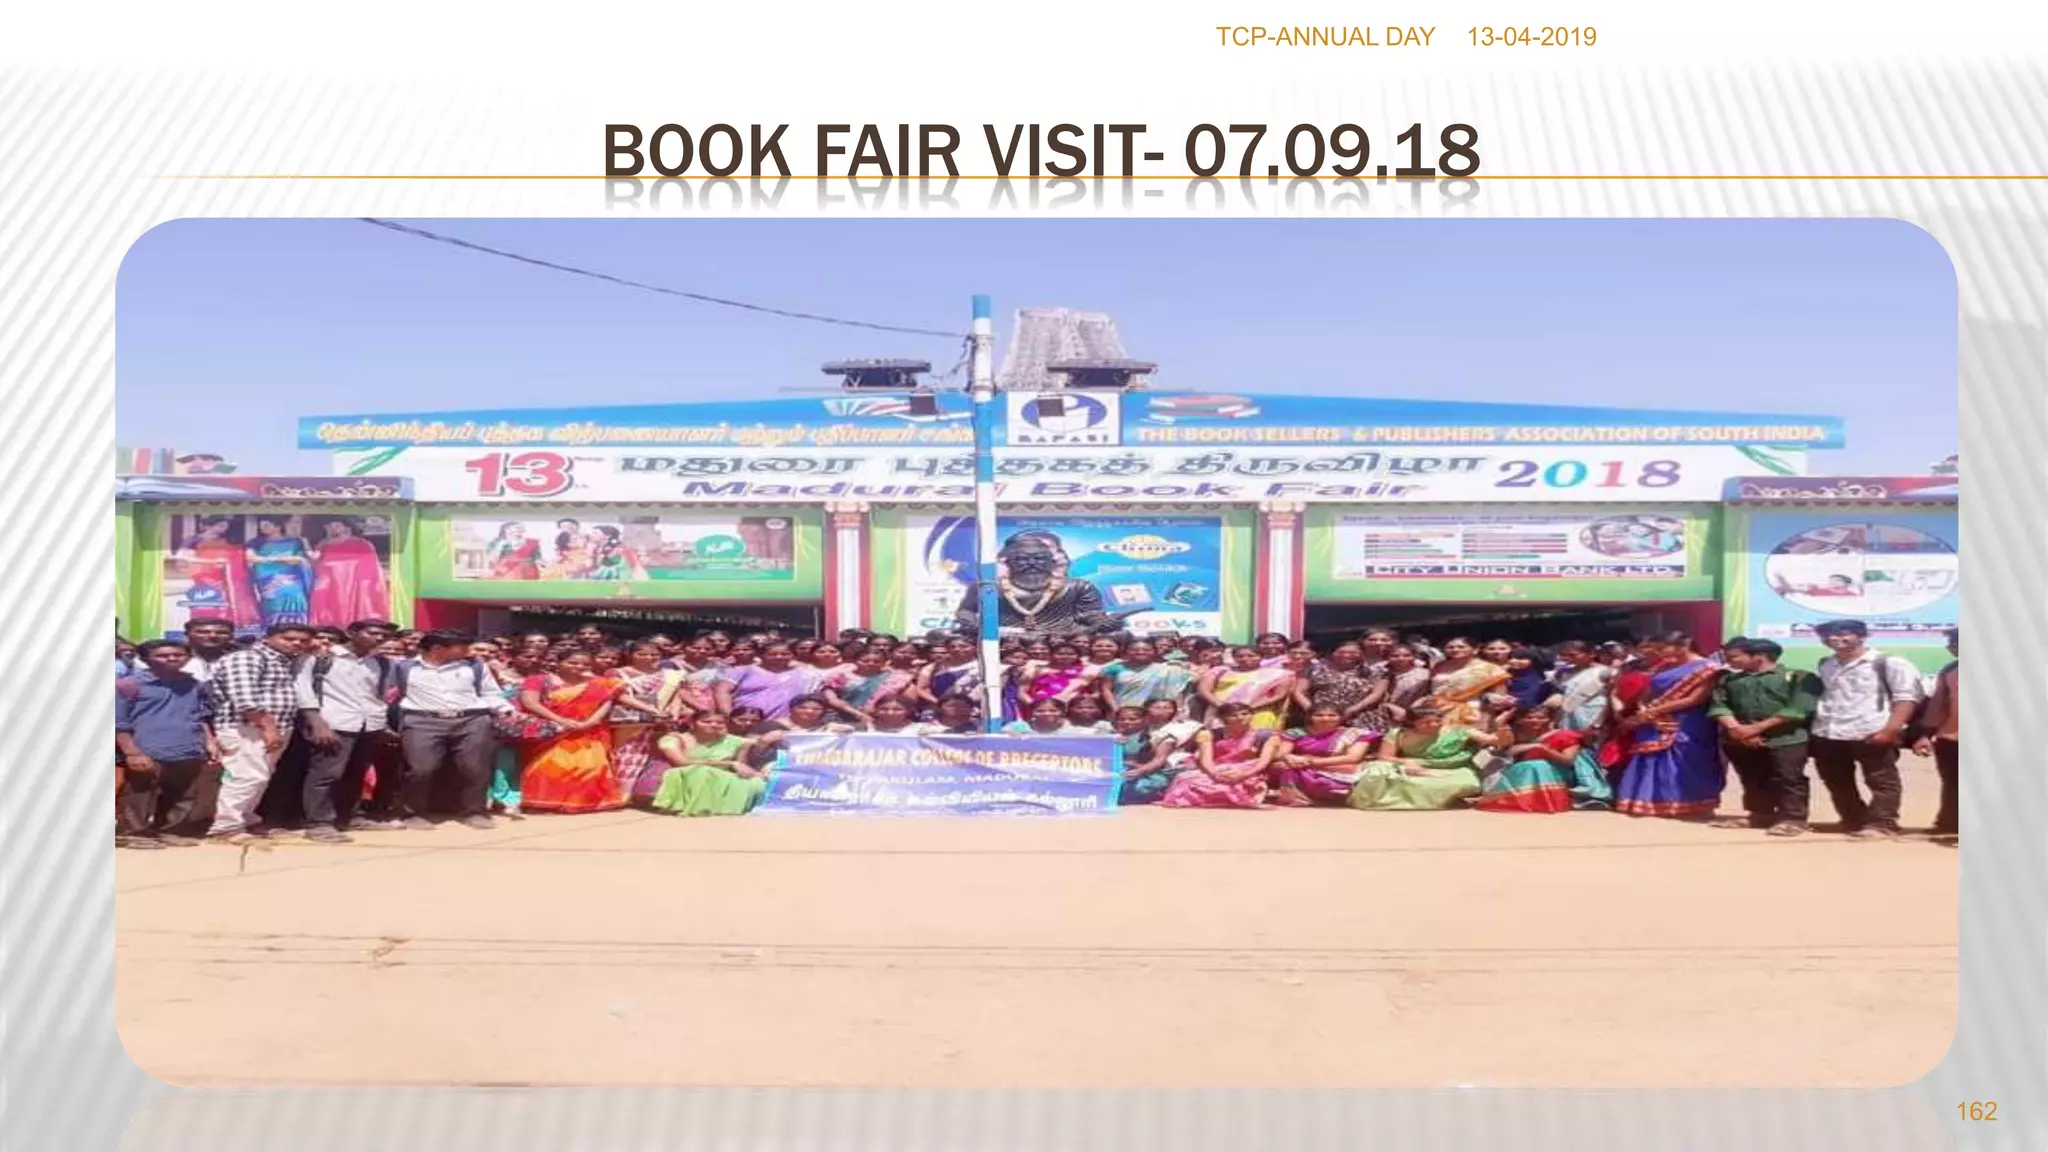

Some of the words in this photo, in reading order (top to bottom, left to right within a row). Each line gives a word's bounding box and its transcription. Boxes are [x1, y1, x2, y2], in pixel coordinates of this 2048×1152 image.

[1141, 427, 1179, 441] THE
[1185, 427, 1248, 441] BOOK
[1254, 427, 1341, 441] SELLERS
[1353, 428, 1367, 441] &
[1373, 427, 1495, 441] PUBLISHERS
[1507, 427, 1649, 441] ASSOCIATION
[1653, 427, 1682, 441] OF
[1687, 427, 1759, 441] SOUTH
[1763, 426, 1824, 441] INDIA
[465, 452, 573, 497] 13
[1494, 460, 1681, 487] 2018
[1031, 482, 1238, 497] Book
[1265, 482, 1425, 497] Fair
[1375, 566, 1437, 575] CITY
[1444, 566, 1530, 575] UNION
[1542, 566, 1618, 575] BANK
